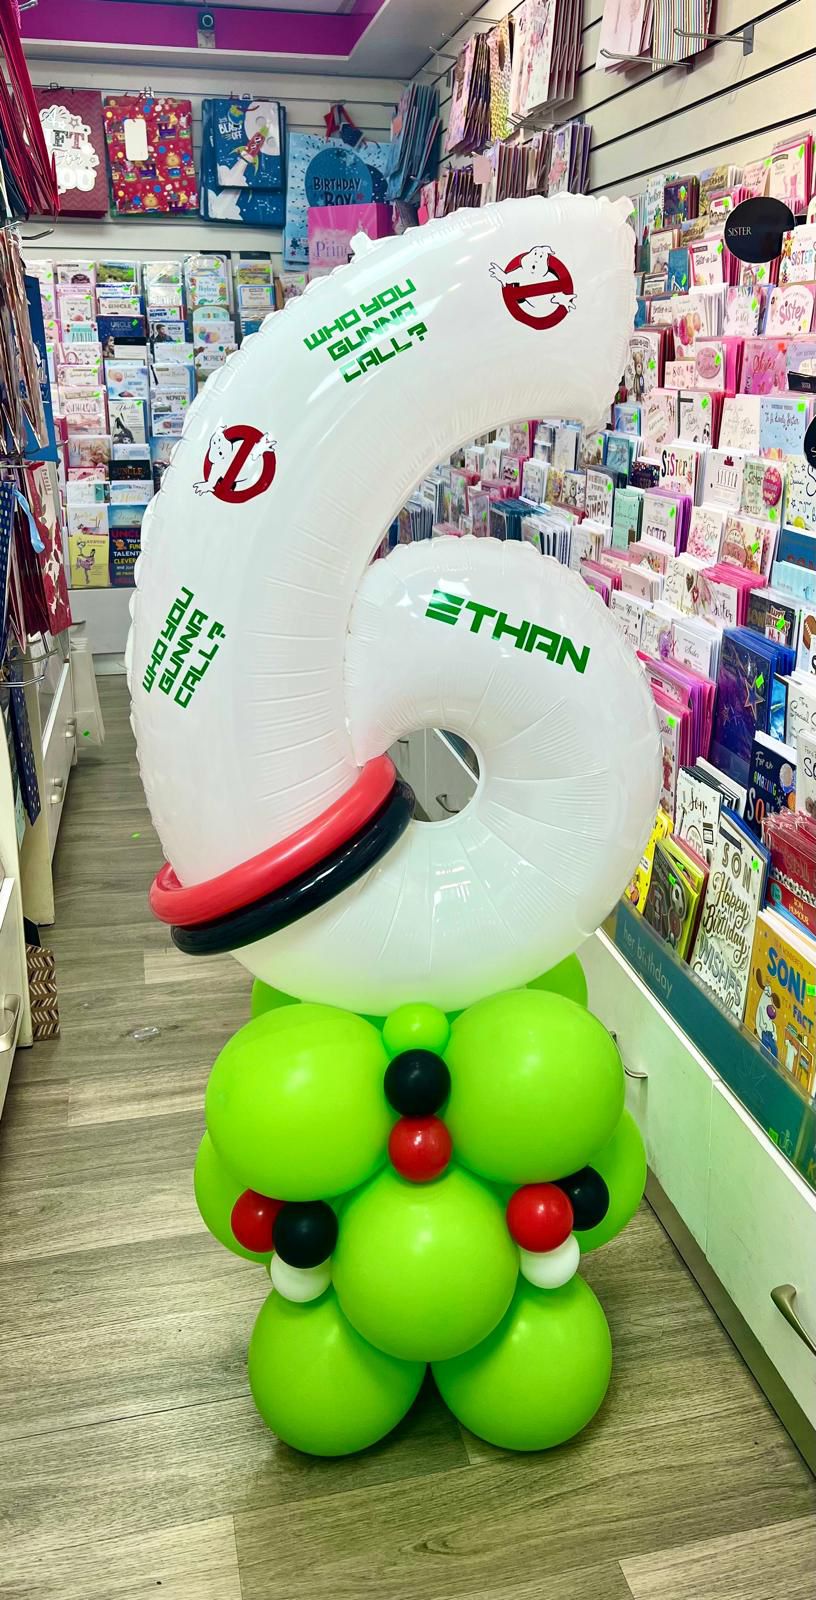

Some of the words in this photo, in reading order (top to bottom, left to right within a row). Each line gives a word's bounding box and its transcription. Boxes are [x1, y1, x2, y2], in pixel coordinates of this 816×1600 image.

[313, 176, 361, 191] BIRTHDAY
[324, 191, 352, 207] BOY
[728, 226, 752, 237] SISTER
[791, 249, 813, 266] SISTER
[303, 308, 361, 351] WHO
[360, 278, 416, 317] YOU
[327, 301, 417, 361] GUNNA
[142, 638, 168, 693] WHO
[160, 586, 194, 641] YOU
[158, 608, 208, 695] GUNNA
[425, 589, 591, 674] ETHAN
[722, 842, 751, 893] SON
[713, 871, 748, 930] Happy
[623, 919, 635, 950] her
[637, 936, 673, 1001] birthday
[702, 904, 748, 970] Birthday
